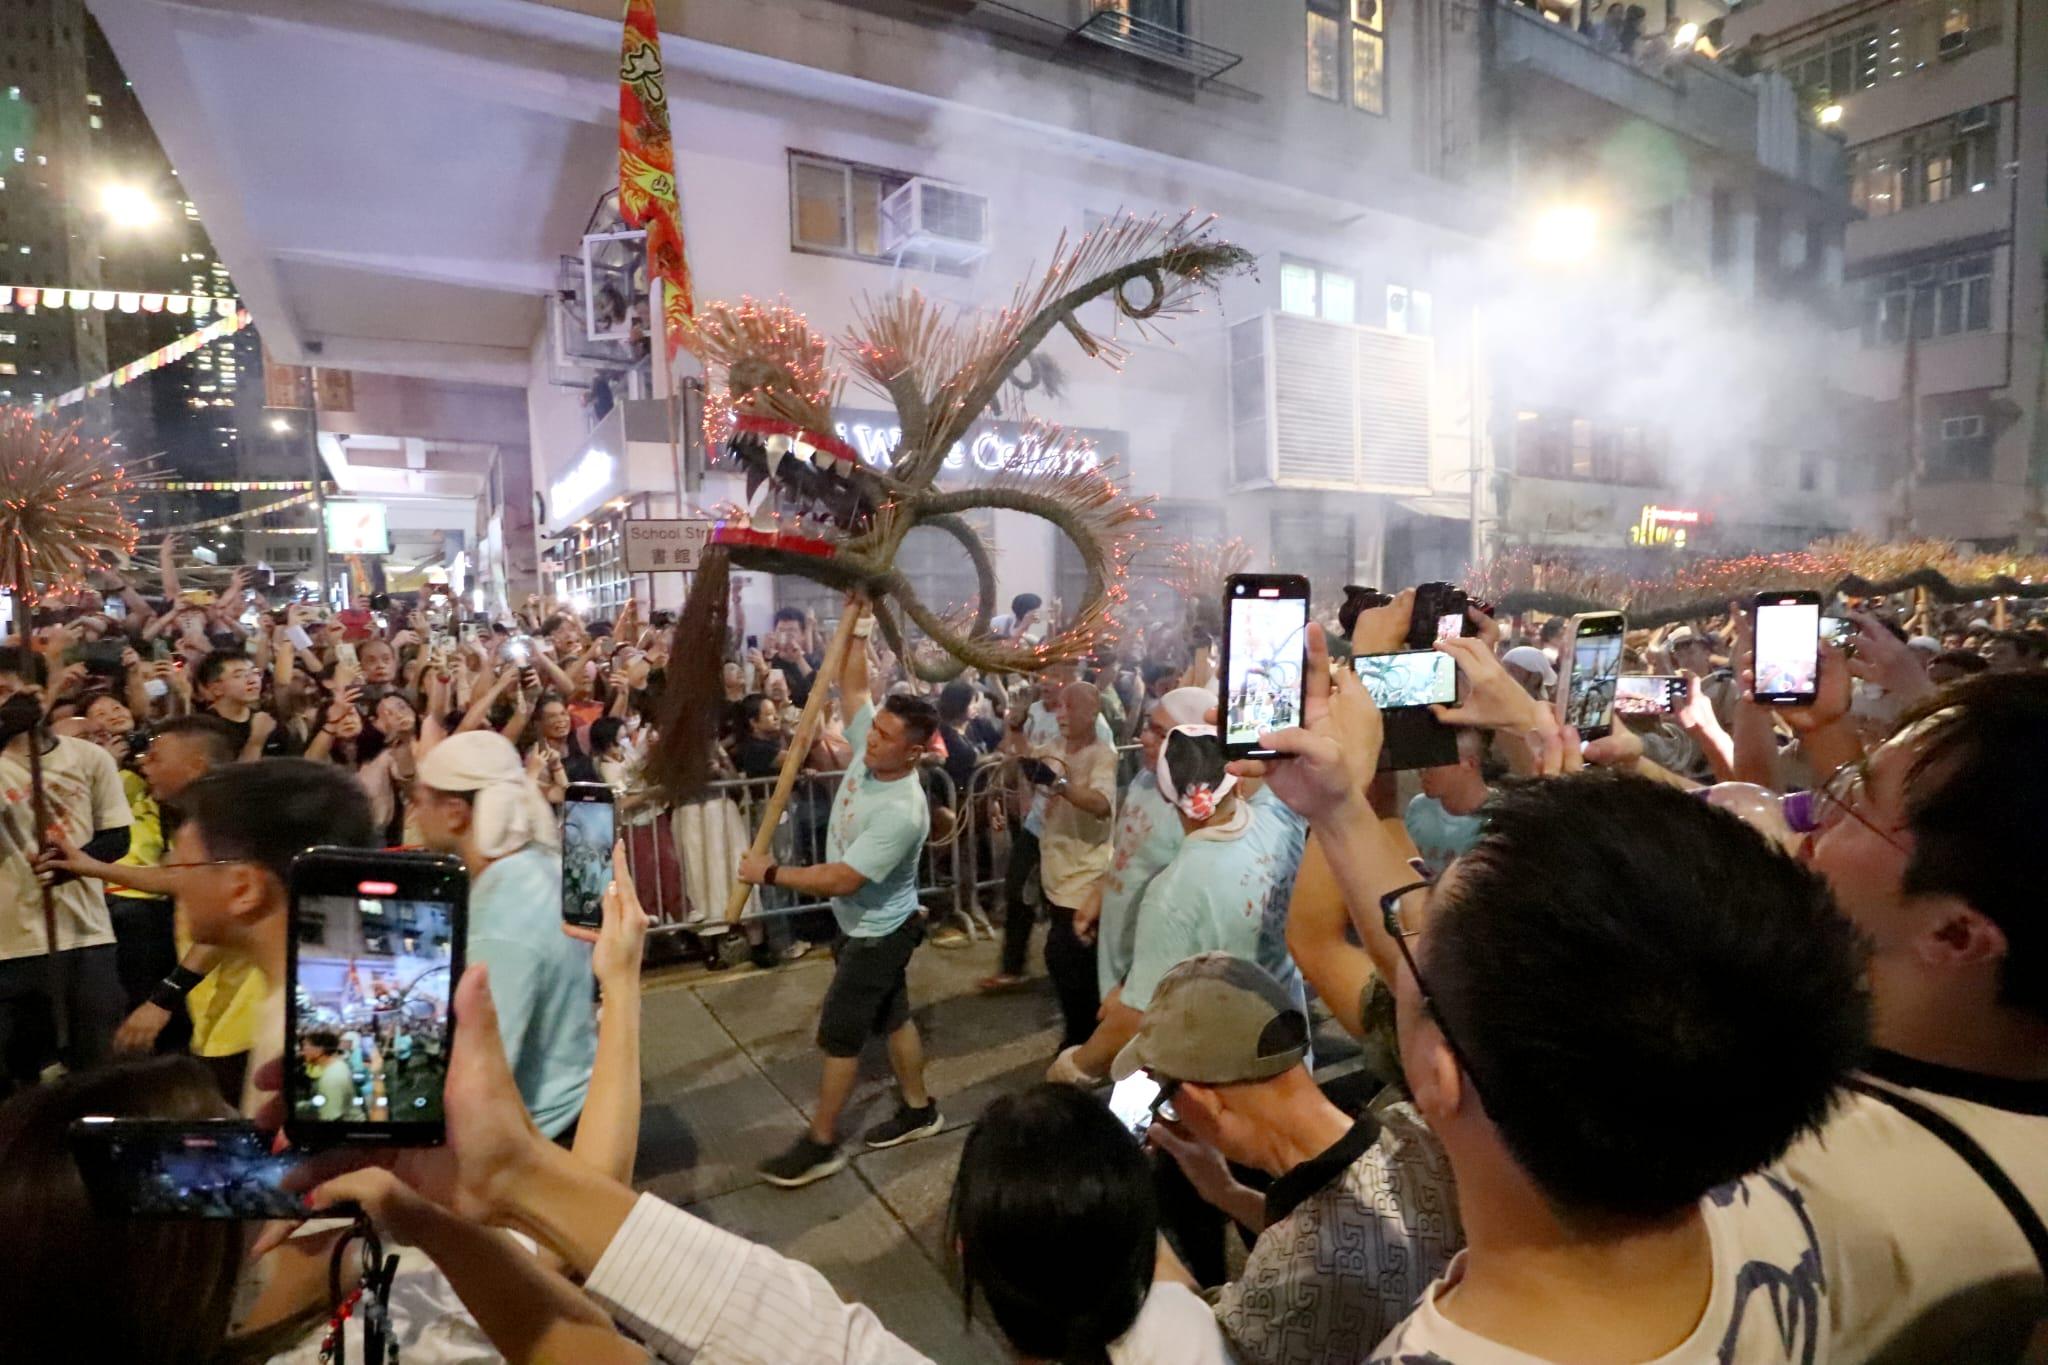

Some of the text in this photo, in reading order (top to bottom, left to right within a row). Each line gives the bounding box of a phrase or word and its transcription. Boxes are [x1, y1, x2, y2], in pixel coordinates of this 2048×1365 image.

[631, 527, 705, 540] School Str
[652, 548, 703, 565] 書館
